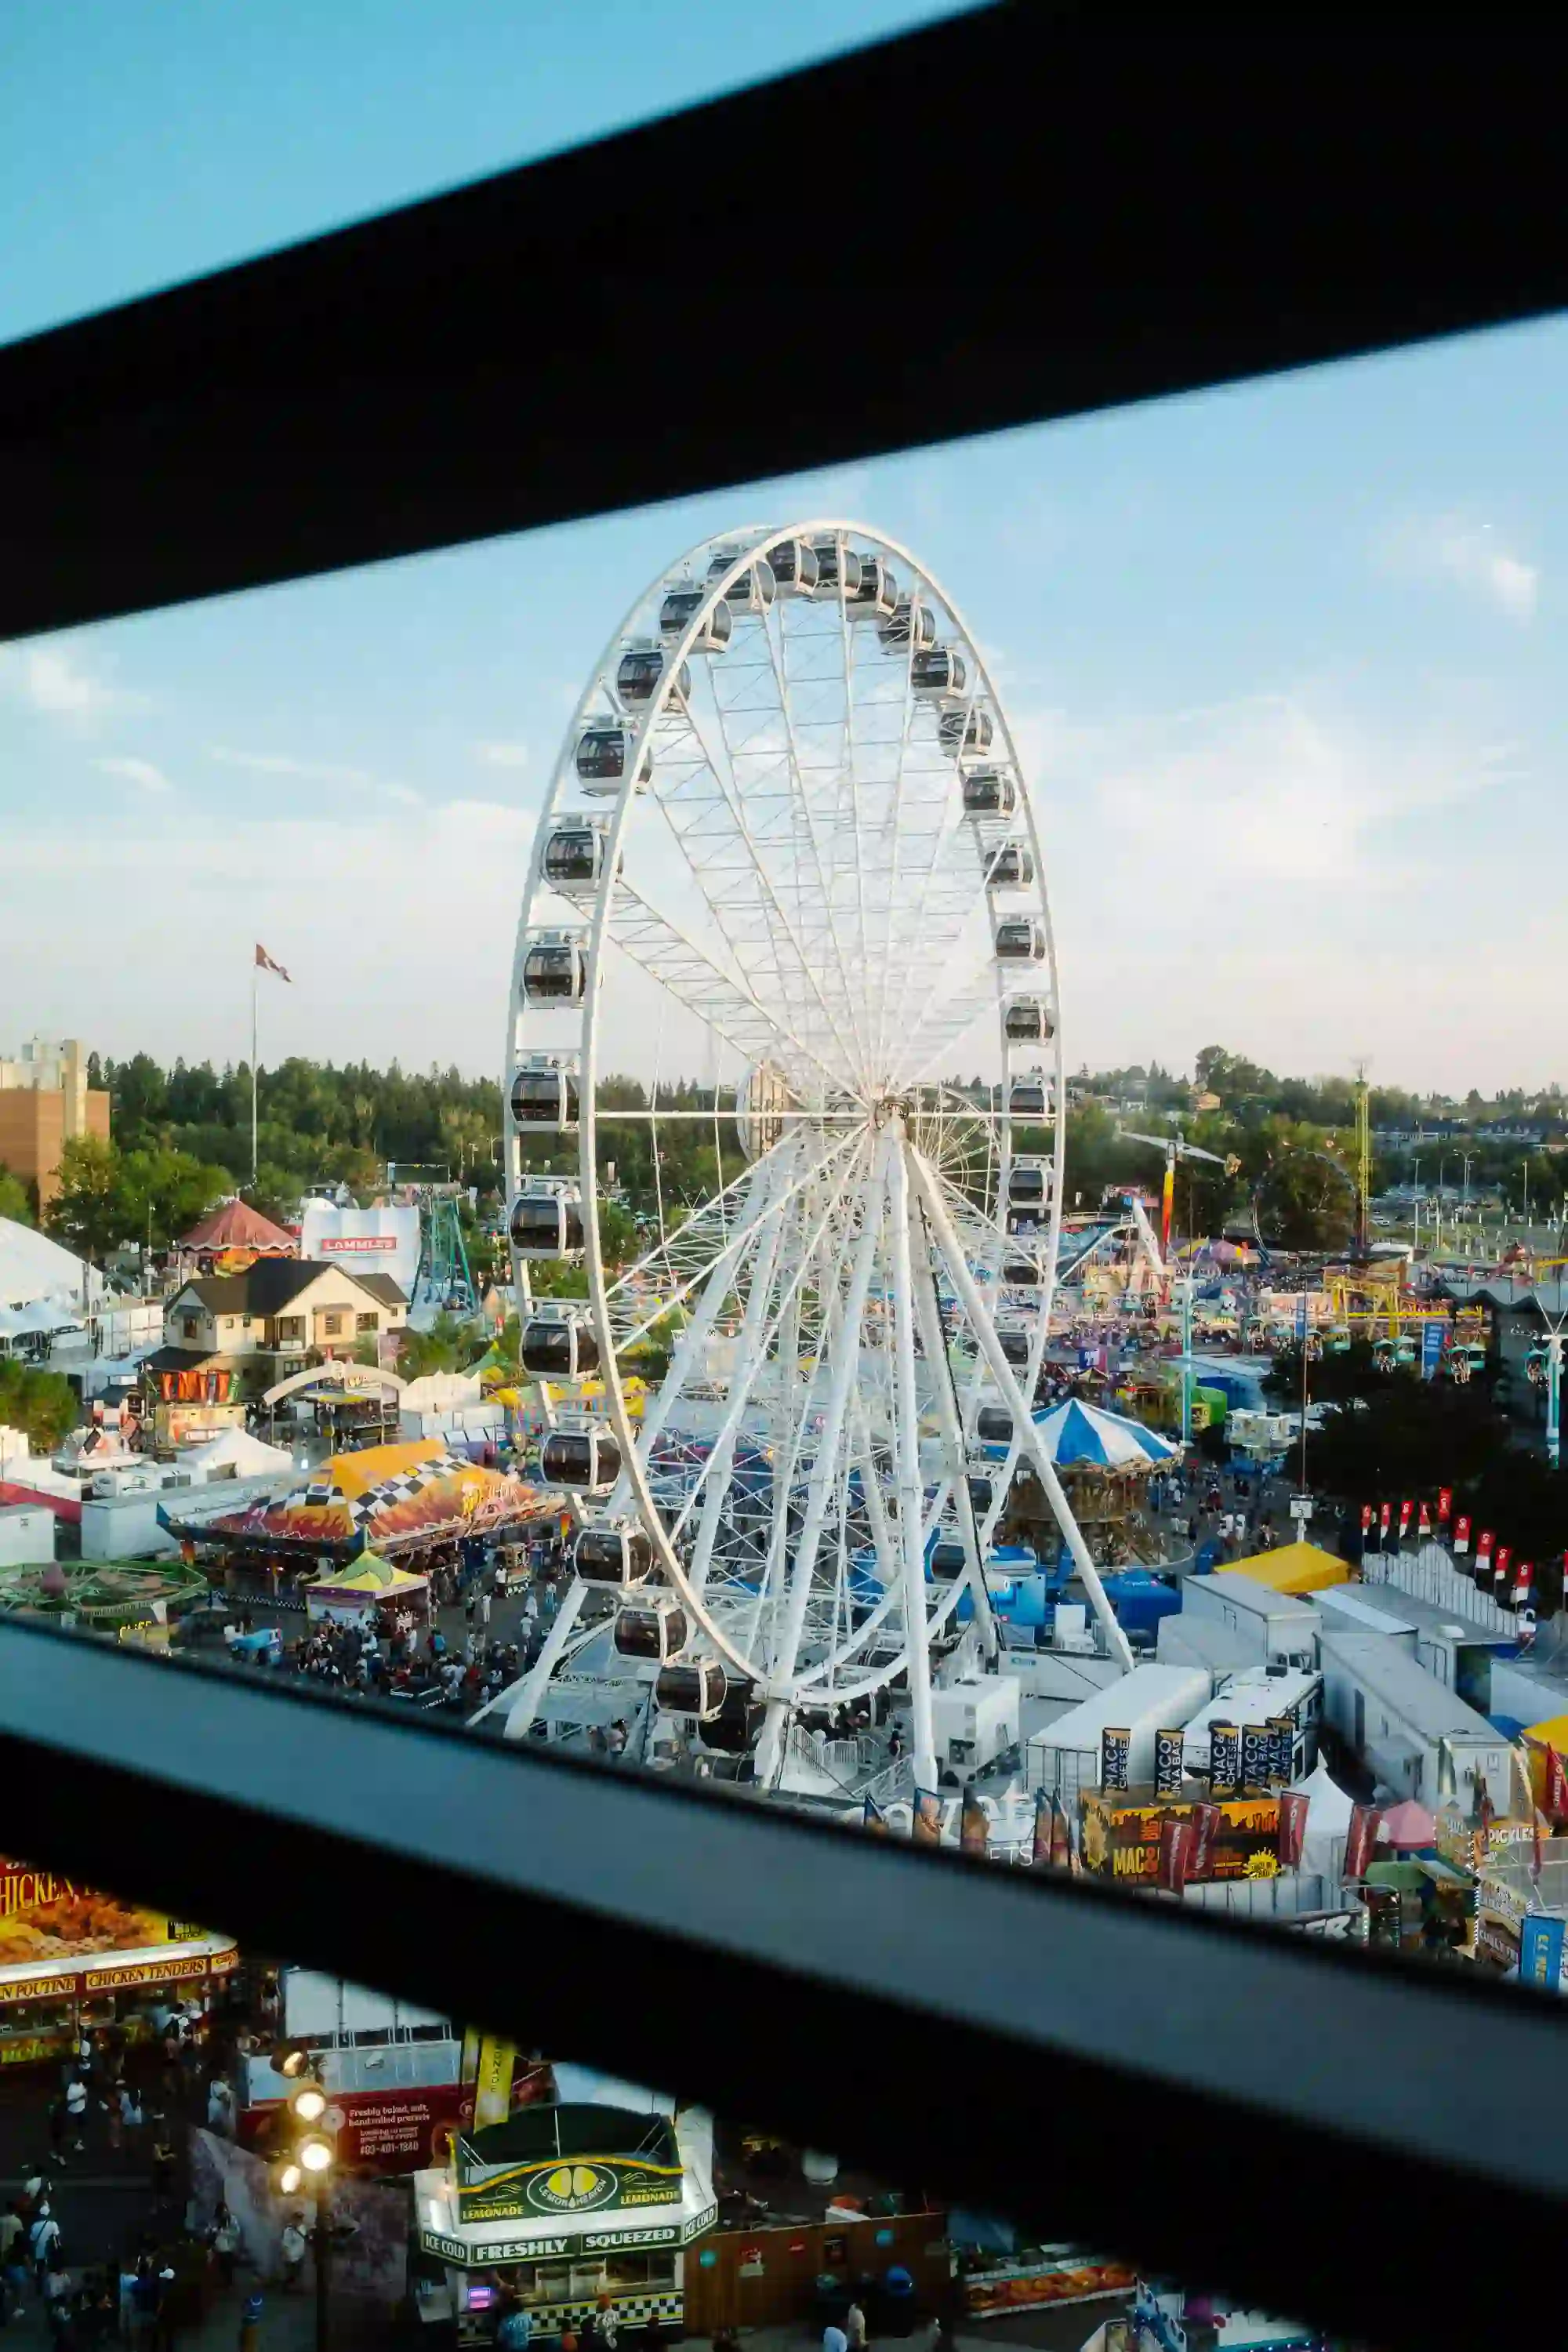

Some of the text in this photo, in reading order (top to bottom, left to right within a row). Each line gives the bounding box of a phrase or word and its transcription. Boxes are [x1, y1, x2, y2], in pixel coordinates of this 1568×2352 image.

[1119, 1736, 1130, 1789] CHEESE
[1158, 1739, 1172, 1791] TACO
[1226, 1729, 1237, 1786] CHEESE
[89, 1969, 145, 1987] CHICKEN
[149, 1959, 205, 1980] TENDERS
[16, 1977, 77, 1998] POUTINE
[539, 2179, 608, 2207] LEMON HEAVEN
[620, 2190, 681, 2205] LEMONADE
[463, 2205, 524, 2220] LEMONADE
[685, 2207, 714, 2238] ICE COLD
[426, 2234, 465, 2259] ICE COLD
[476, 2229, 676, 2260] FRESHLY SQUEEZED
